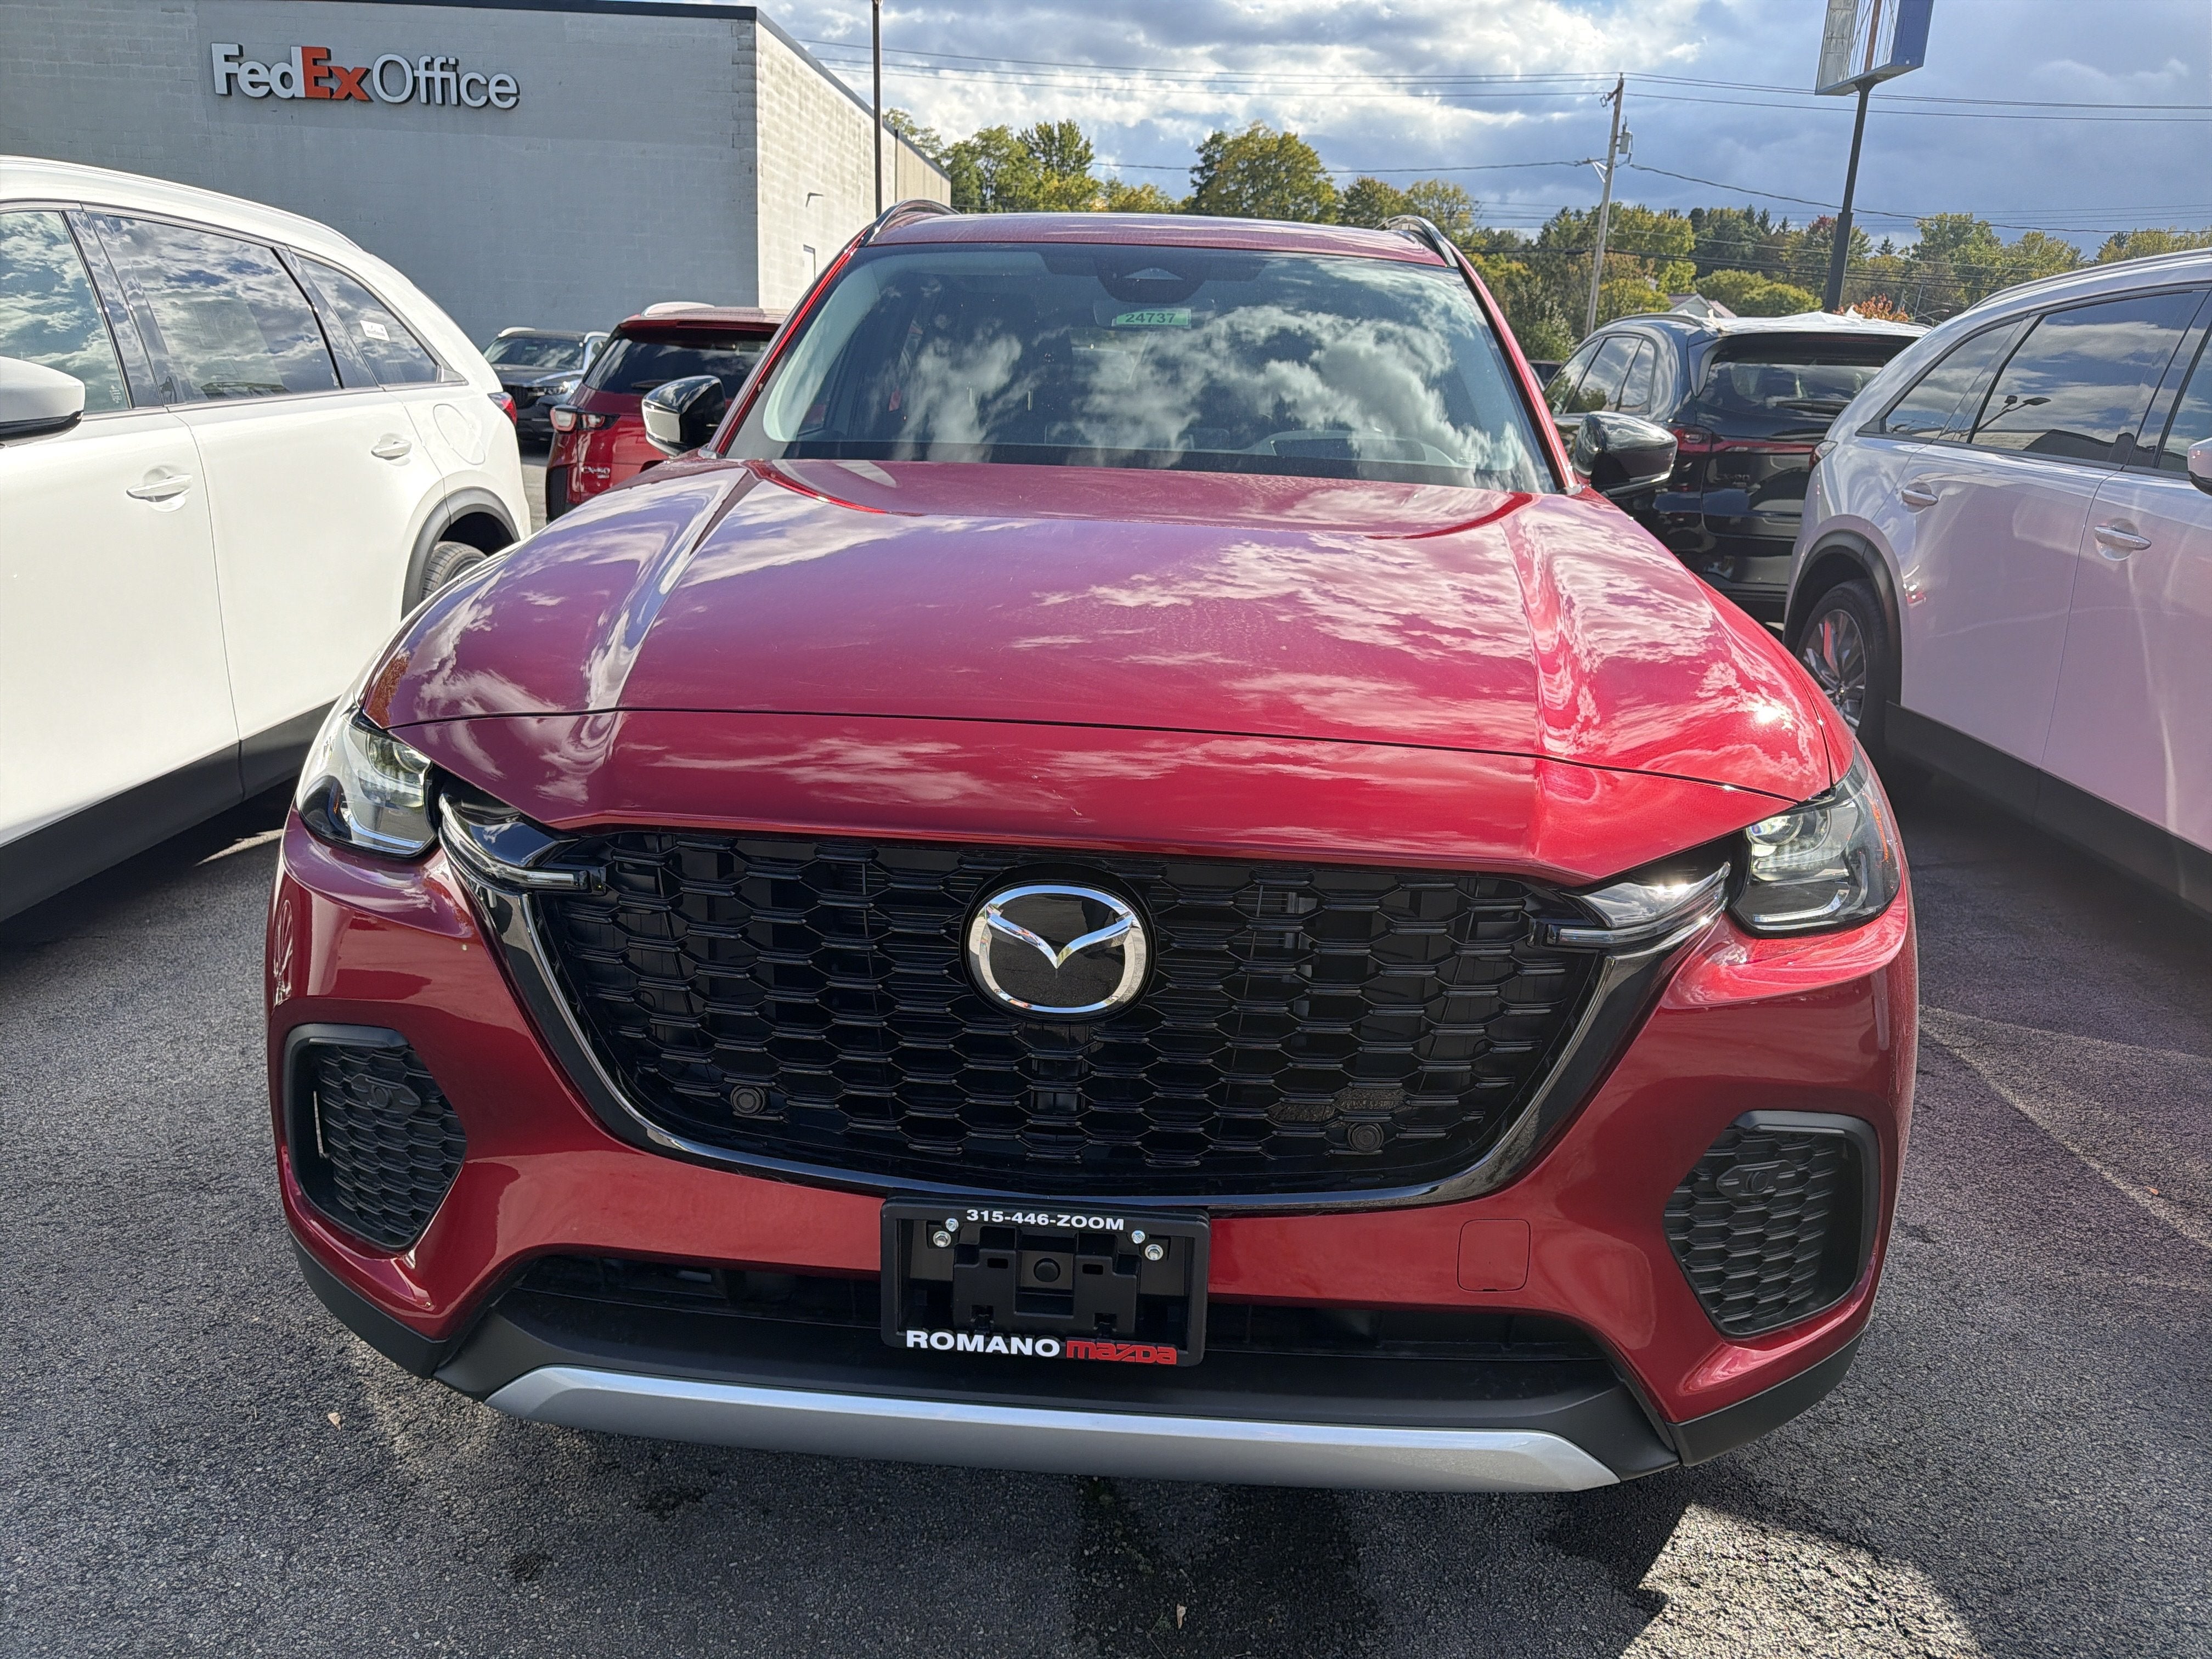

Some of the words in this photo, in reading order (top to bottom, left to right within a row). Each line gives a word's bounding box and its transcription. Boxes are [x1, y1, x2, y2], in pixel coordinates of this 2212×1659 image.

[1125, 312, 1176, 324] 24737
[966, 1209, 1125, 1231] 315-446-ZOOM
[906, 1329, 1060, 1358] ROMANO
[1066, 1340, 1177, 1365] mazda
